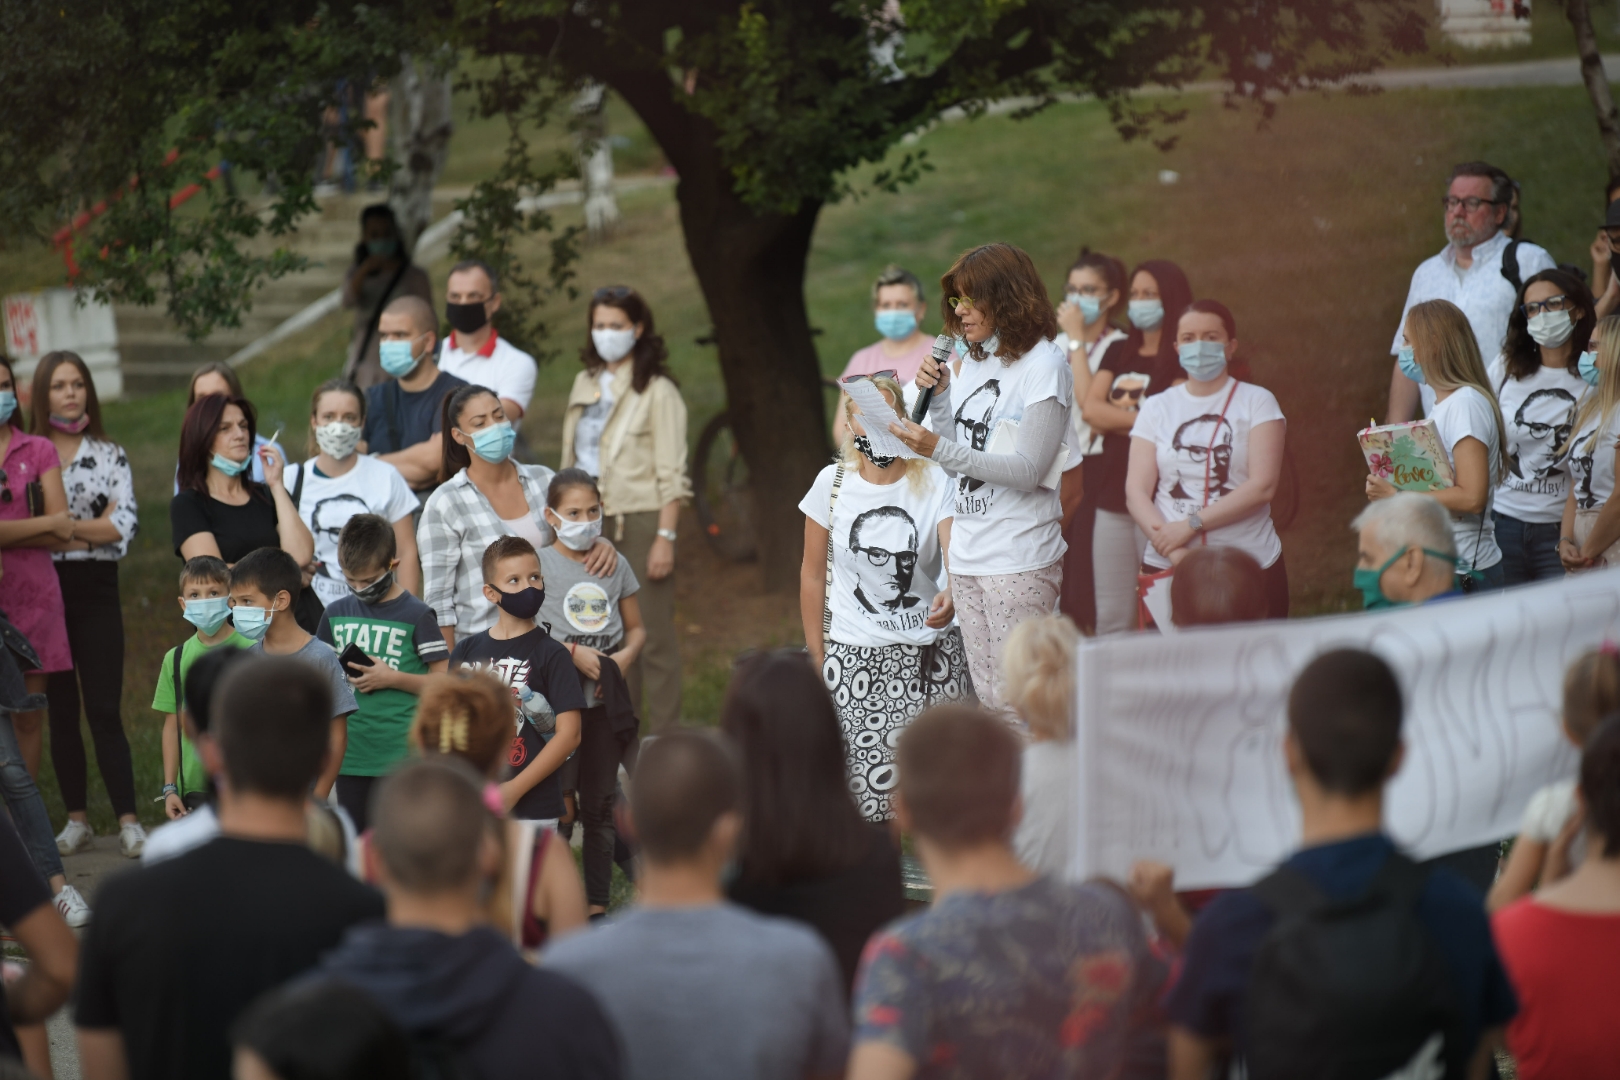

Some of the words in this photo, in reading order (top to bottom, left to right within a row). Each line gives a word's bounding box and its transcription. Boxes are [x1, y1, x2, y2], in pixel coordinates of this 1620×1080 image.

[1537, 476, 1566, 497] Иву!
[965, 488, 994, 515] Иву!
[899, 605, 929, 631] Иву!
[333, 623, 407, 657] STATE
